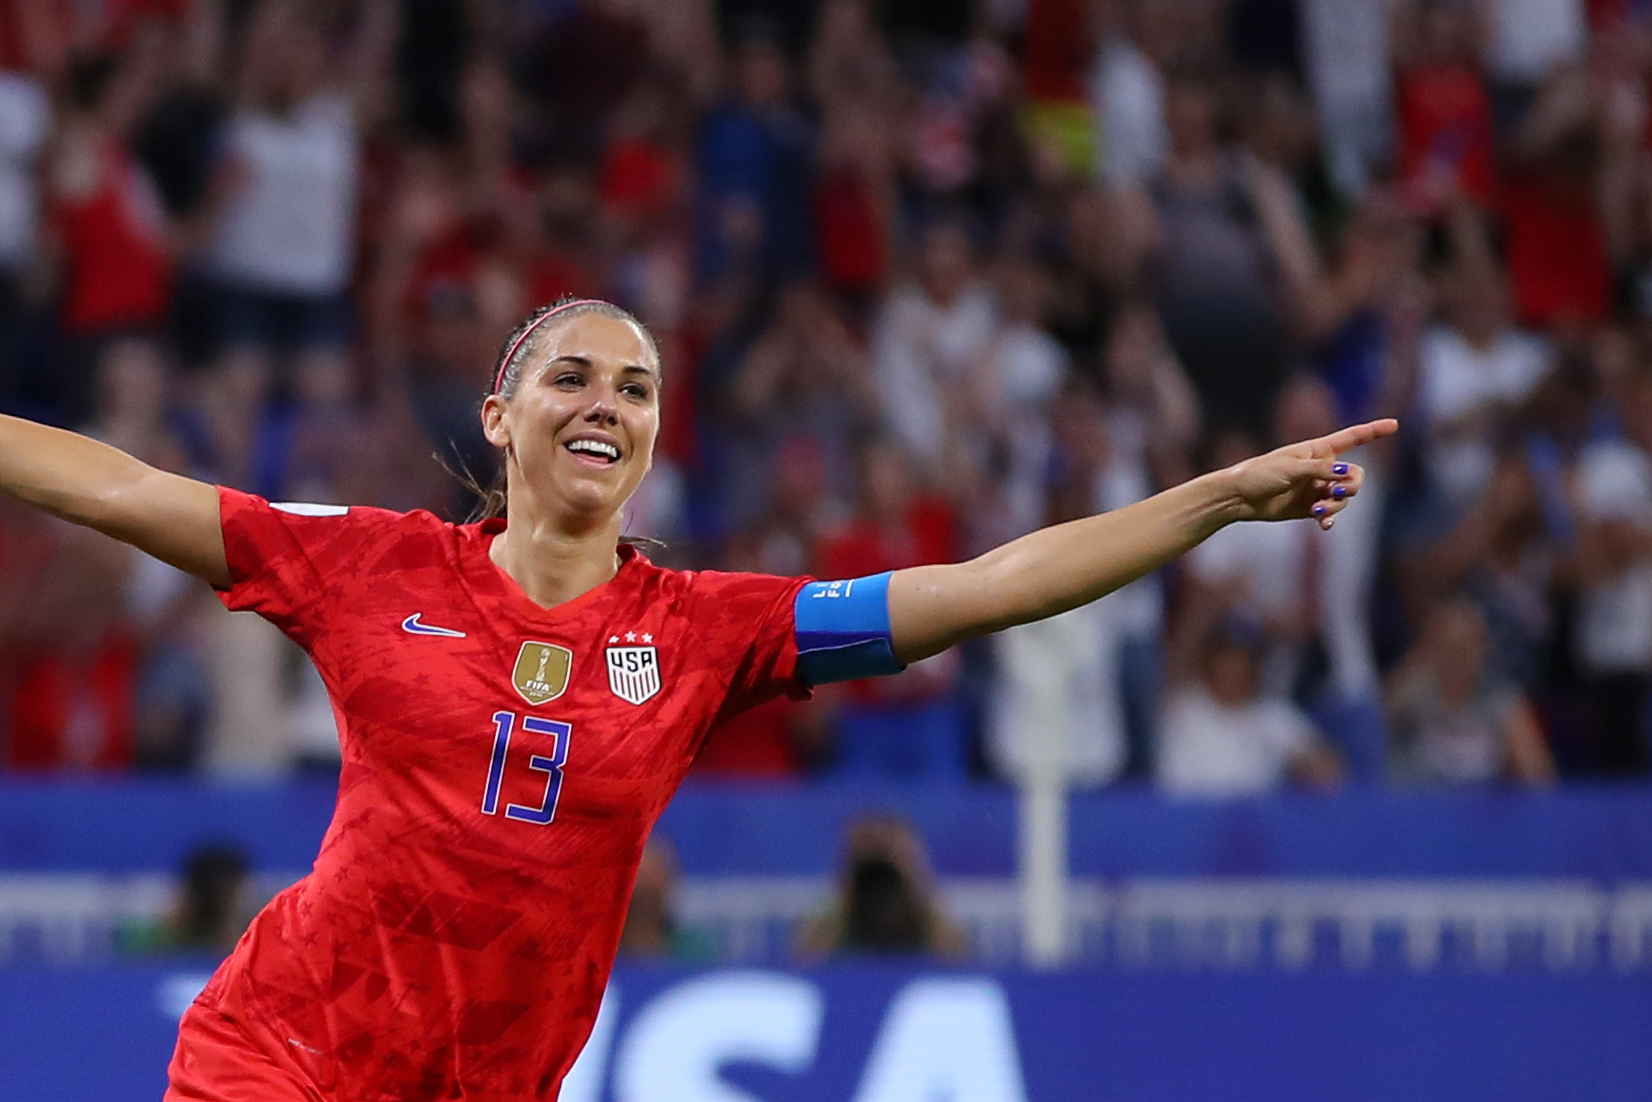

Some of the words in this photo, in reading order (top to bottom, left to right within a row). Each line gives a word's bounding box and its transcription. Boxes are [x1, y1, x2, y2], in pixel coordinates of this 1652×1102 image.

[610, 650, 653, 673] USA
[526, 680, 550, 692] FIFA
[481, 710, 572, 825] 13
